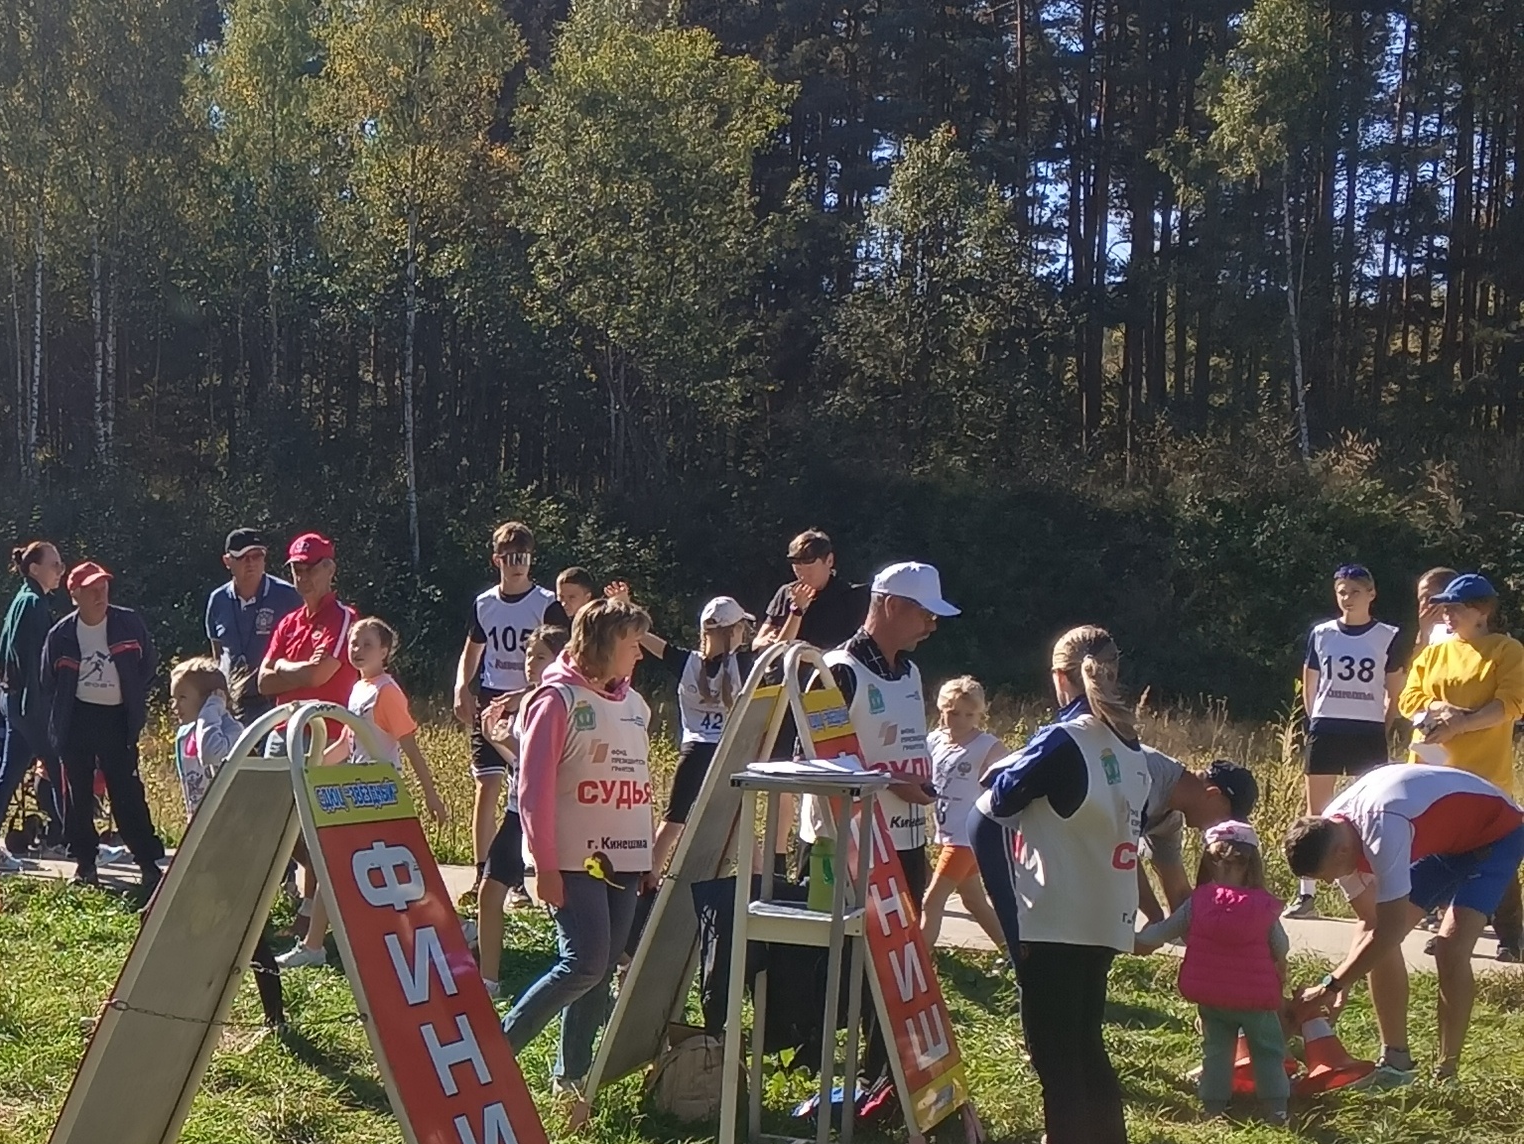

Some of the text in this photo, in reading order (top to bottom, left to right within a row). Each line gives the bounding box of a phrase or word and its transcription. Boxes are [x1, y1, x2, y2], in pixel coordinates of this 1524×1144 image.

[488, 626, 535, 653] 105
[1324, 655, 1376, 683] 138
[701, 712, 723, 730] 42
[577, 780, 654, 809] СУДЬЯ
[587, 837, 648, 850] г. Кинешма
